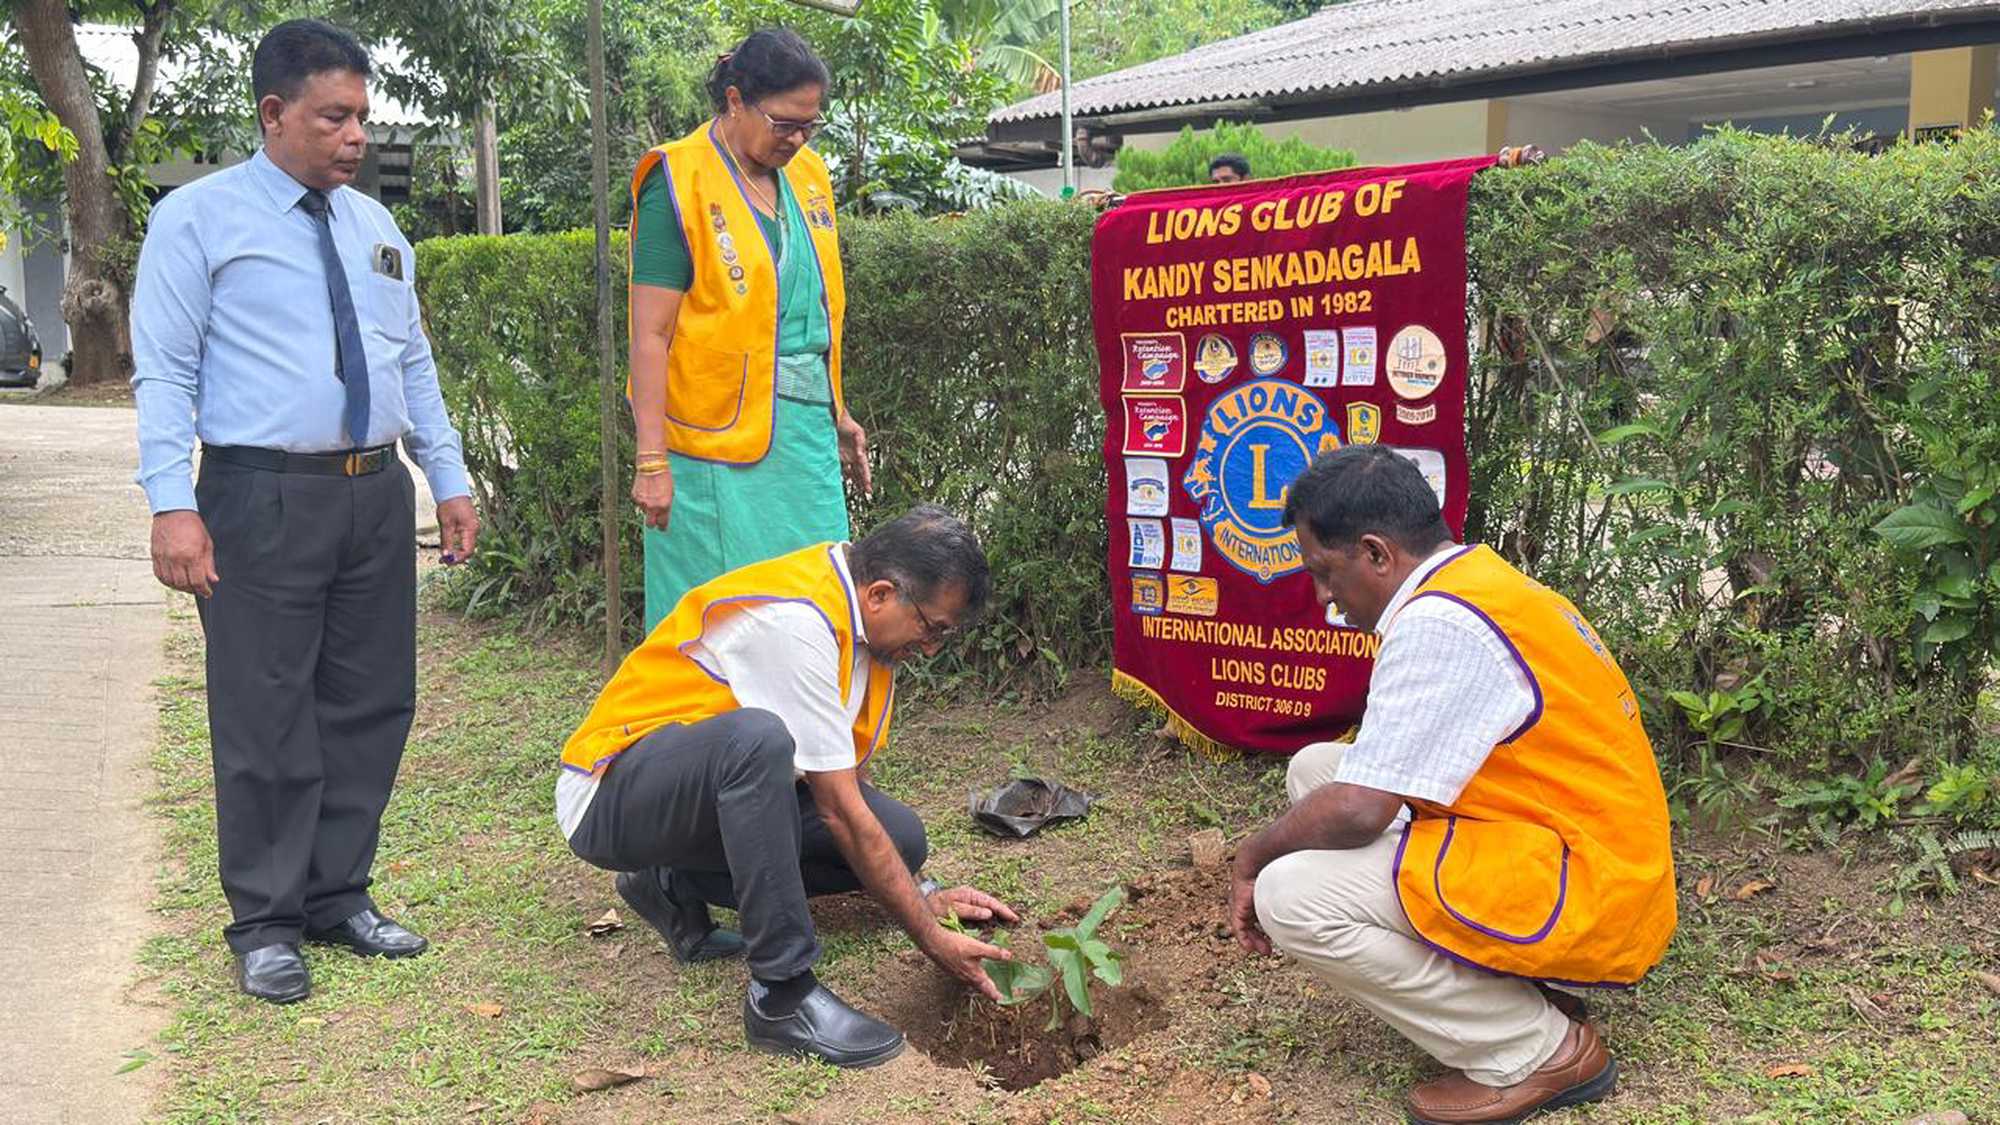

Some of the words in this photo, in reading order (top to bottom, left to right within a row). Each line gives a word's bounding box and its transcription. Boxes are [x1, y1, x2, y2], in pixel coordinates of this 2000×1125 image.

[1146, 203, 1243, 244] LIONS
[1250, 190, 1345, 232] CLUB
[1354, 179, 1406, 217] OF
[1123, 261, 1205, 300] KANDY
[1212, 237, 1421, 293] SENKADAGALA
[1166, 299, 1284, 328] CHARTERED
[1291, 295, 1314, 318] IN
[1321, 290, 1372, 316] 1982
[1216, 386, 1319, 429] LIONS
[1247, 444, 1289, 509] L
[1142, 615, 1267, 649] INTERNATIONAL
[1269, 628, 1380, 659] ASSOCIATION
[1212, 658, 1265, 685] LIONS
[1271, 664, 1327, 692] CLUBS
[1215, 692, 1273, 712] DISTRICT
[1273, 699, 1293, 714] 306
